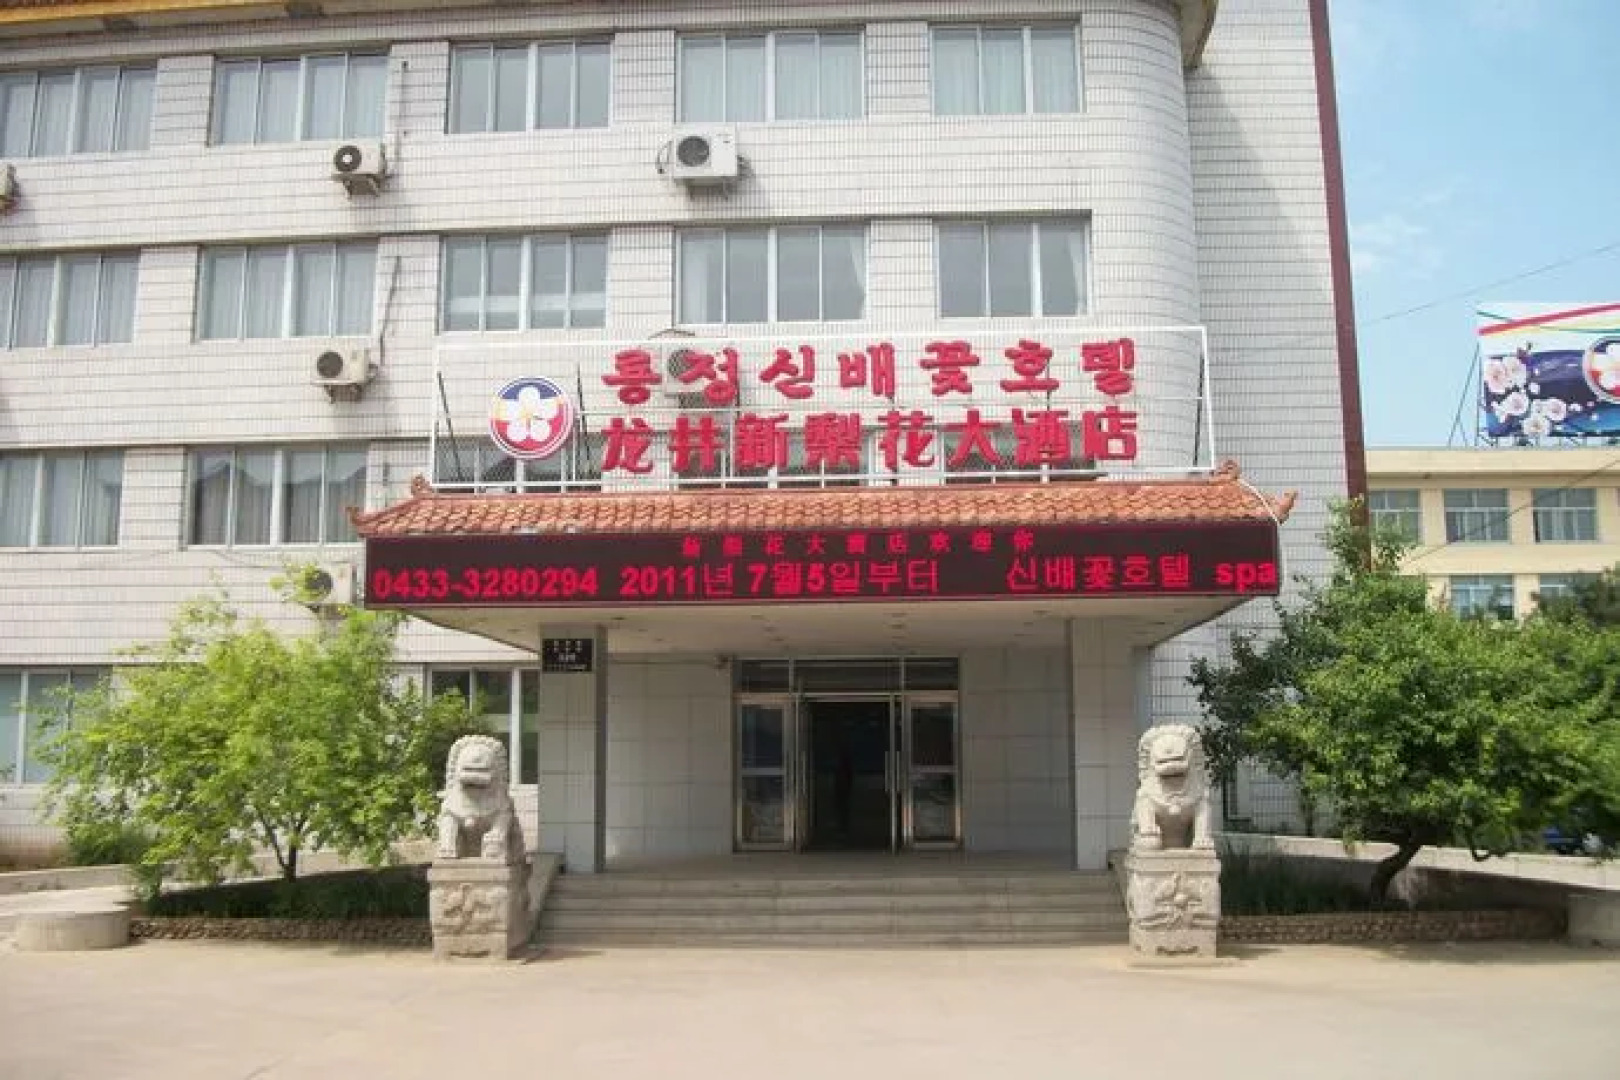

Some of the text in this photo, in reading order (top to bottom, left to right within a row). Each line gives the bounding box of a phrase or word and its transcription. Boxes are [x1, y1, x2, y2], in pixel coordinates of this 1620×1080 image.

[601, 406, 1137, 473] 龙井新梨花大酒店
[373, 567, 599, 598] 0433-3280294
[619, 563, 734, 597] 2011년
[1006, 555, 1190, 592] 신배꽃호텔
[1215, 563, 1277, 592] spa
